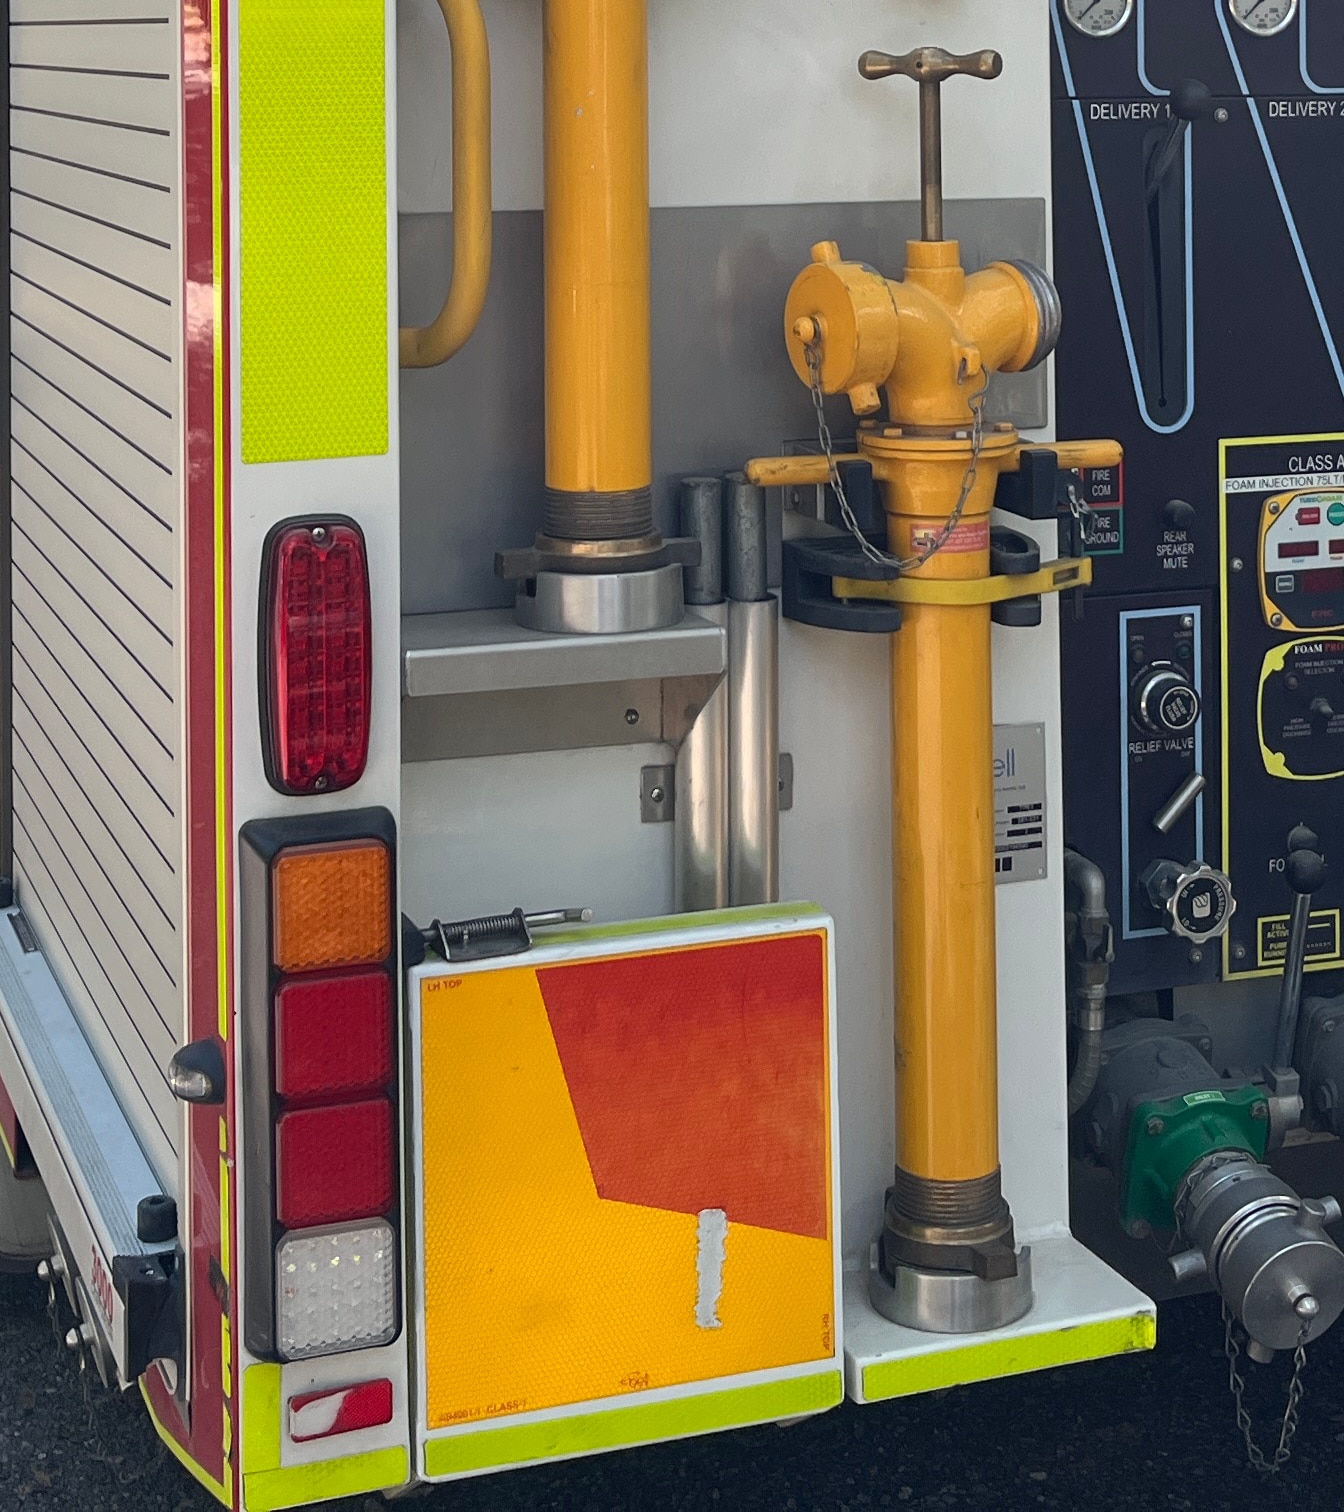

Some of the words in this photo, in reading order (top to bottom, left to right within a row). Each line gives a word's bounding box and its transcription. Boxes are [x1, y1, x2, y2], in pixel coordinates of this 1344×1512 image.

[1090, 103, 1161, 120] DELIVERY
[1164, 103, 1171, 119] 1
[1269, 102, 1336, 117] DELIVERY
[1288, 455, 1333, 472] CLASS
[1092, 469, 1110, 481] FIRE
[1092, 484, 1111, 496] COM
[1225, 479, 1256, 492] FOAM
[1259, 474, 1314, 488] INJECTION
[1085, 531, 1120, 545] GROUND
[1164, 530, 1186, 542] REAR
[1156, 543, 1194, 557] SPEAKER
[1164, 556, 1188, 570] MUTE
[1294, 644, 1323, 655] FOAM
[1324, 642, 1344, 652] PRO
[1128, 740, 1161, 754] RELIEF
[1164, 736, 1194, 751] VALVE
[443, 979, 462, 989] TOP
[486, 1400, 519, 1414] CLASS
